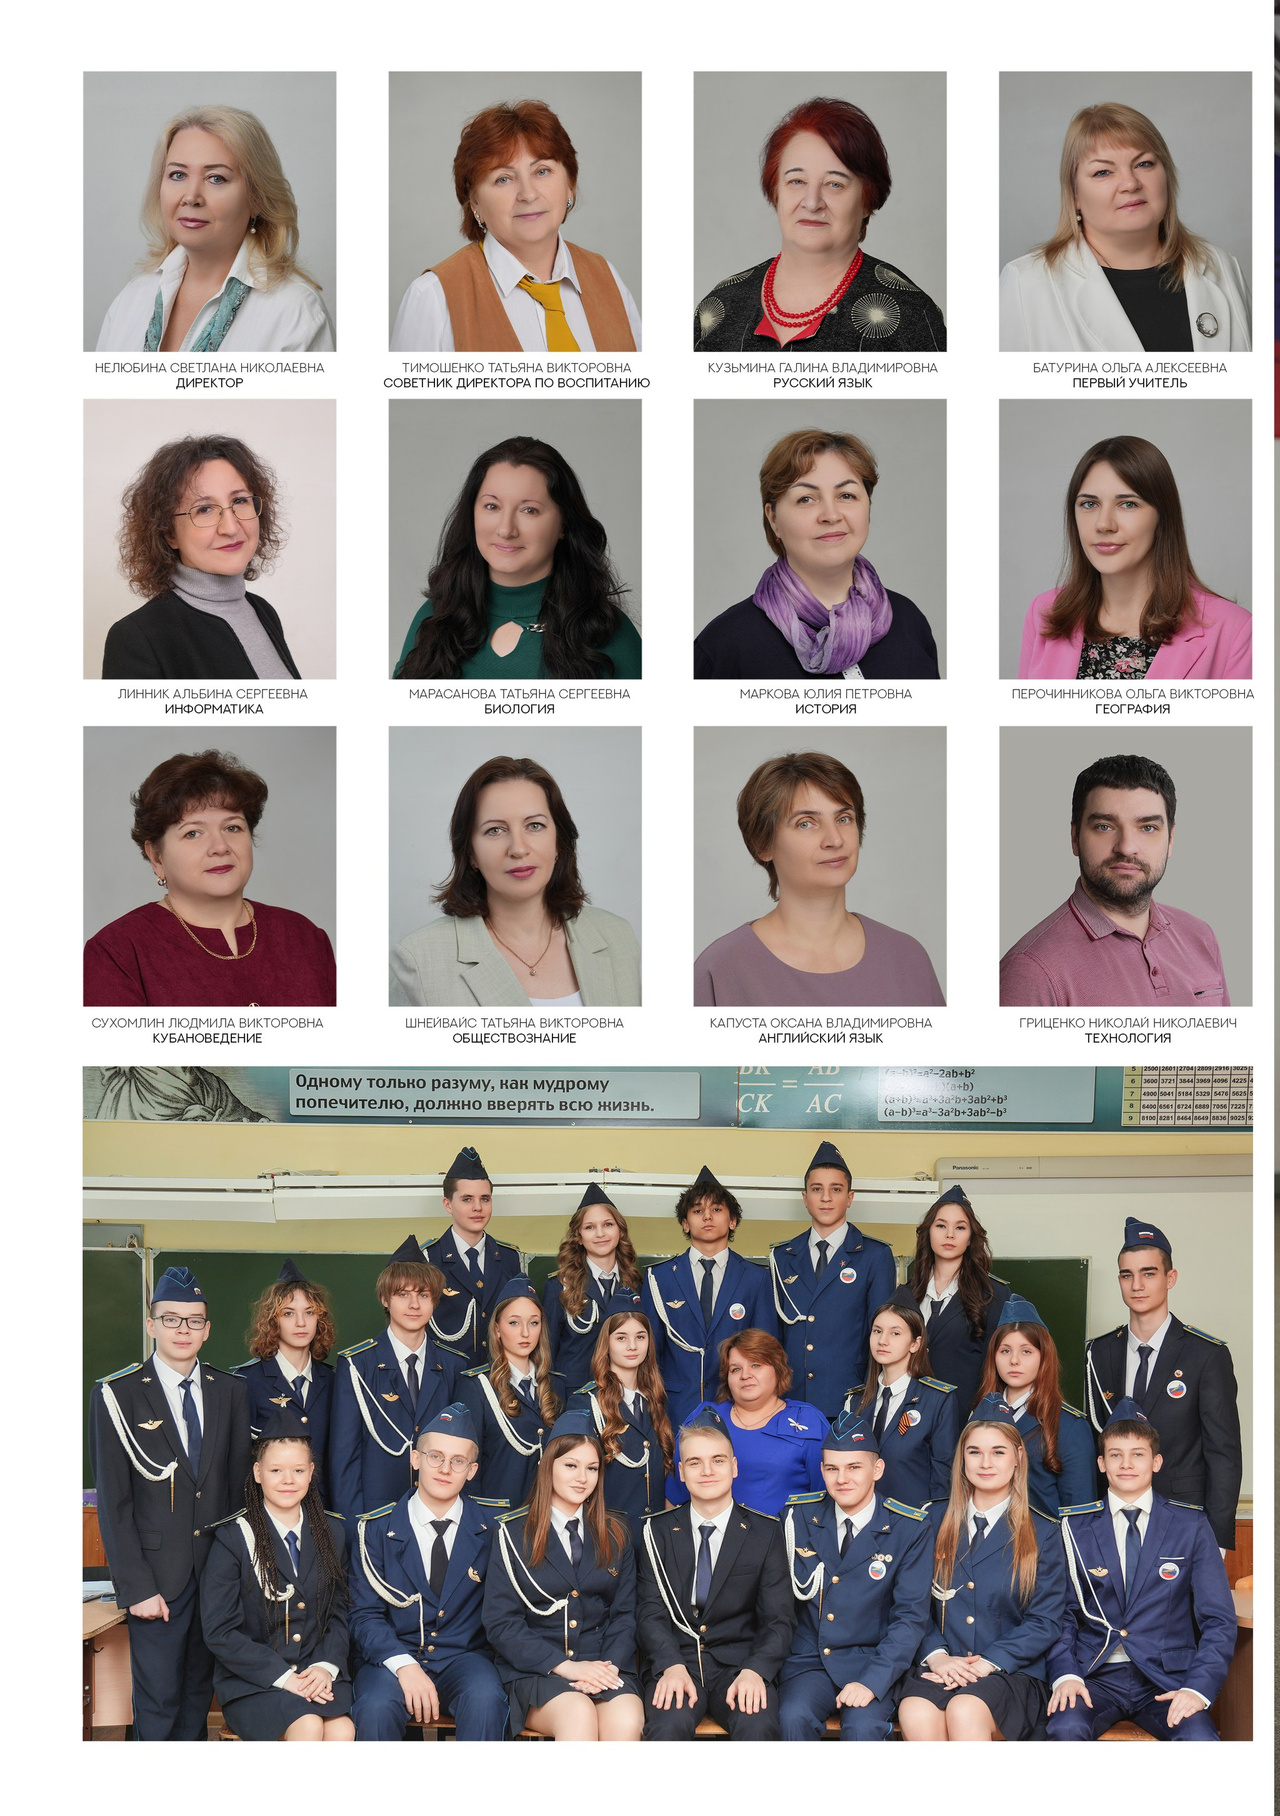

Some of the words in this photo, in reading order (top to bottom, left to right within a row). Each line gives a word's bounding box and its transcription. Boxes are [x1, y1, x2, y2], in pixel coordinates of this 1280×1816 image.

[295, 1074, 362, 1090] Одному
[367, 1077, 427, 1089] только
[431, 1078, 495, 1092] разуму,
[500, 1079, 529, 1090] как
[533, 1079, 610, 1093] мудрому
[295, 1097, 409, 1112] попечителю,
[413, 1099, 482, 1112] должно
[487, 1100, 555, 1113] вверять
[559, 1100, 593, 1111] всю
[597, 1101, 655, 1112] жизнь.
